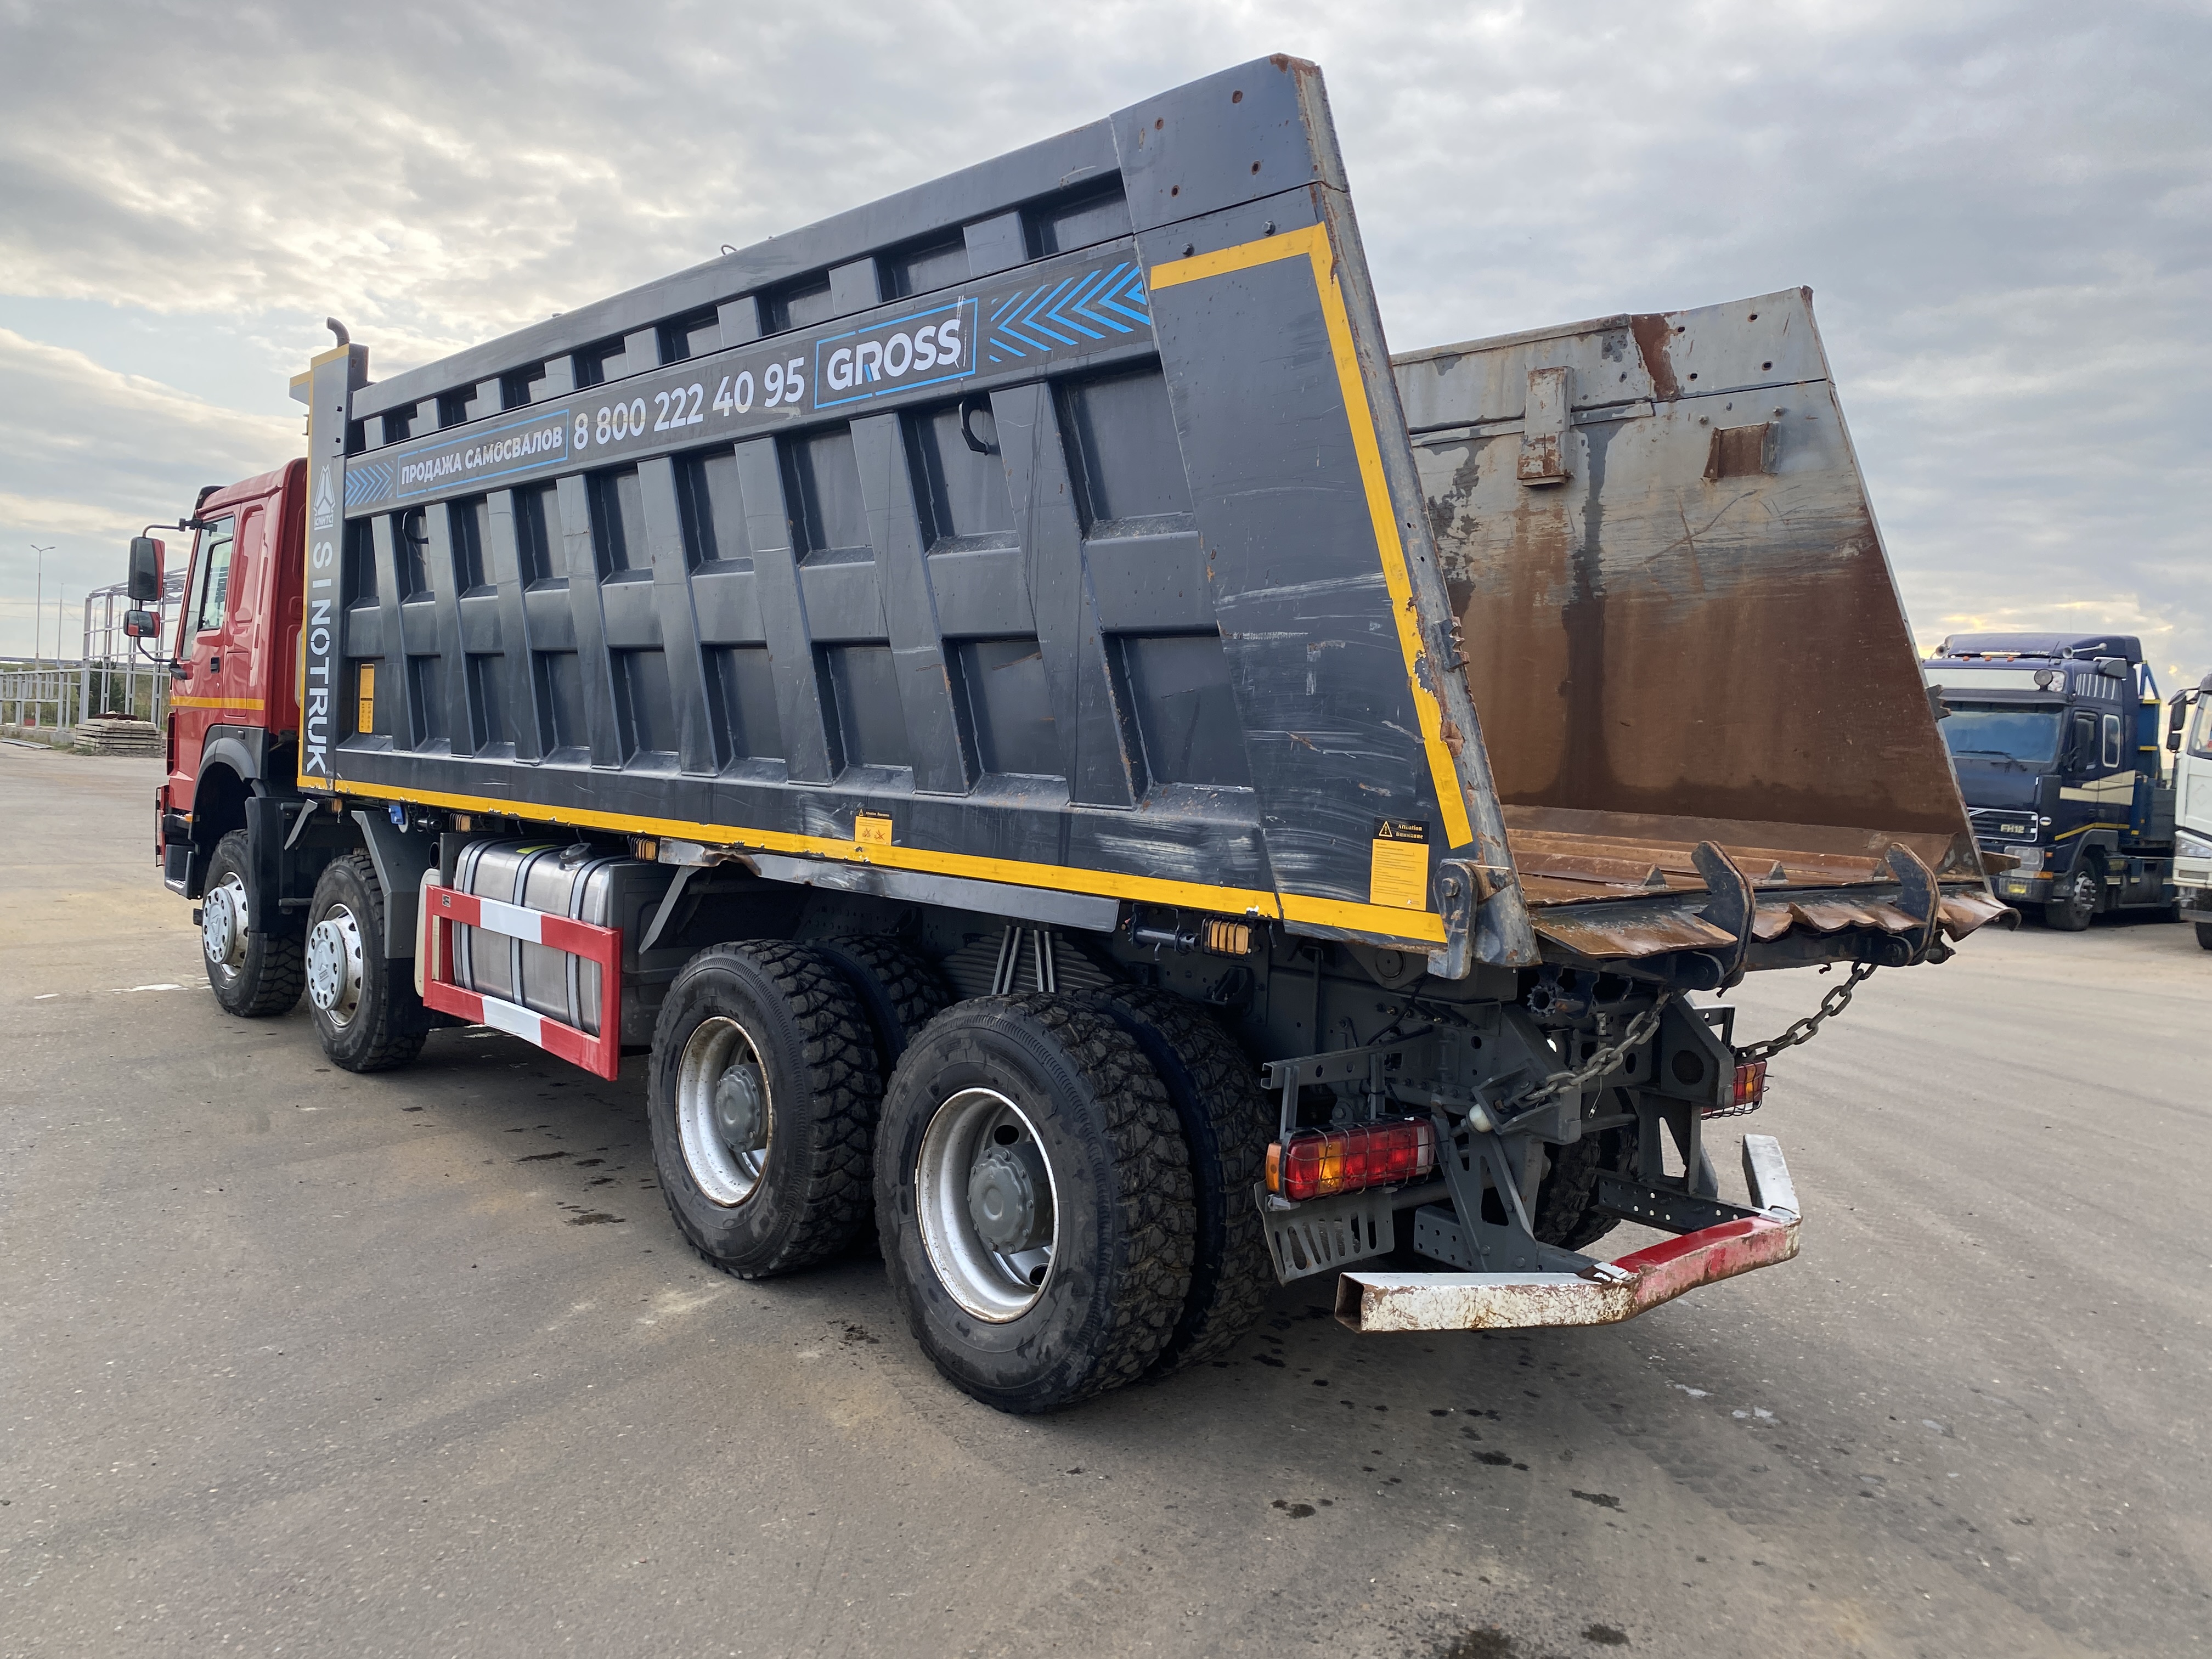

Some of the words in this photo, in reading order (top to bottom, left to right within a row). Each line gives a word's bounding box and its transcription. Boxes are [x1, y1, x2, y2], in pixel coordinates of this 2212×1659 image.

[827, 319, 961, 391] GROSS
[573, 413, 589, 450] 8
[596, 397, 646, 444] 800
[654, 383, 704, 432] 222
[712, 371, 754, 417] 40
[764, 357, 805, 407] 95
[402, 453, 461, 485] ПРОДАЖА
[465, 426, 562, 470] САМОСВАЛОВ
[315, 515, 332, 527] CNHTC
[307, 541, 332, 774] SINOTRUK
[2001, 824, 2024, 833] FH12
